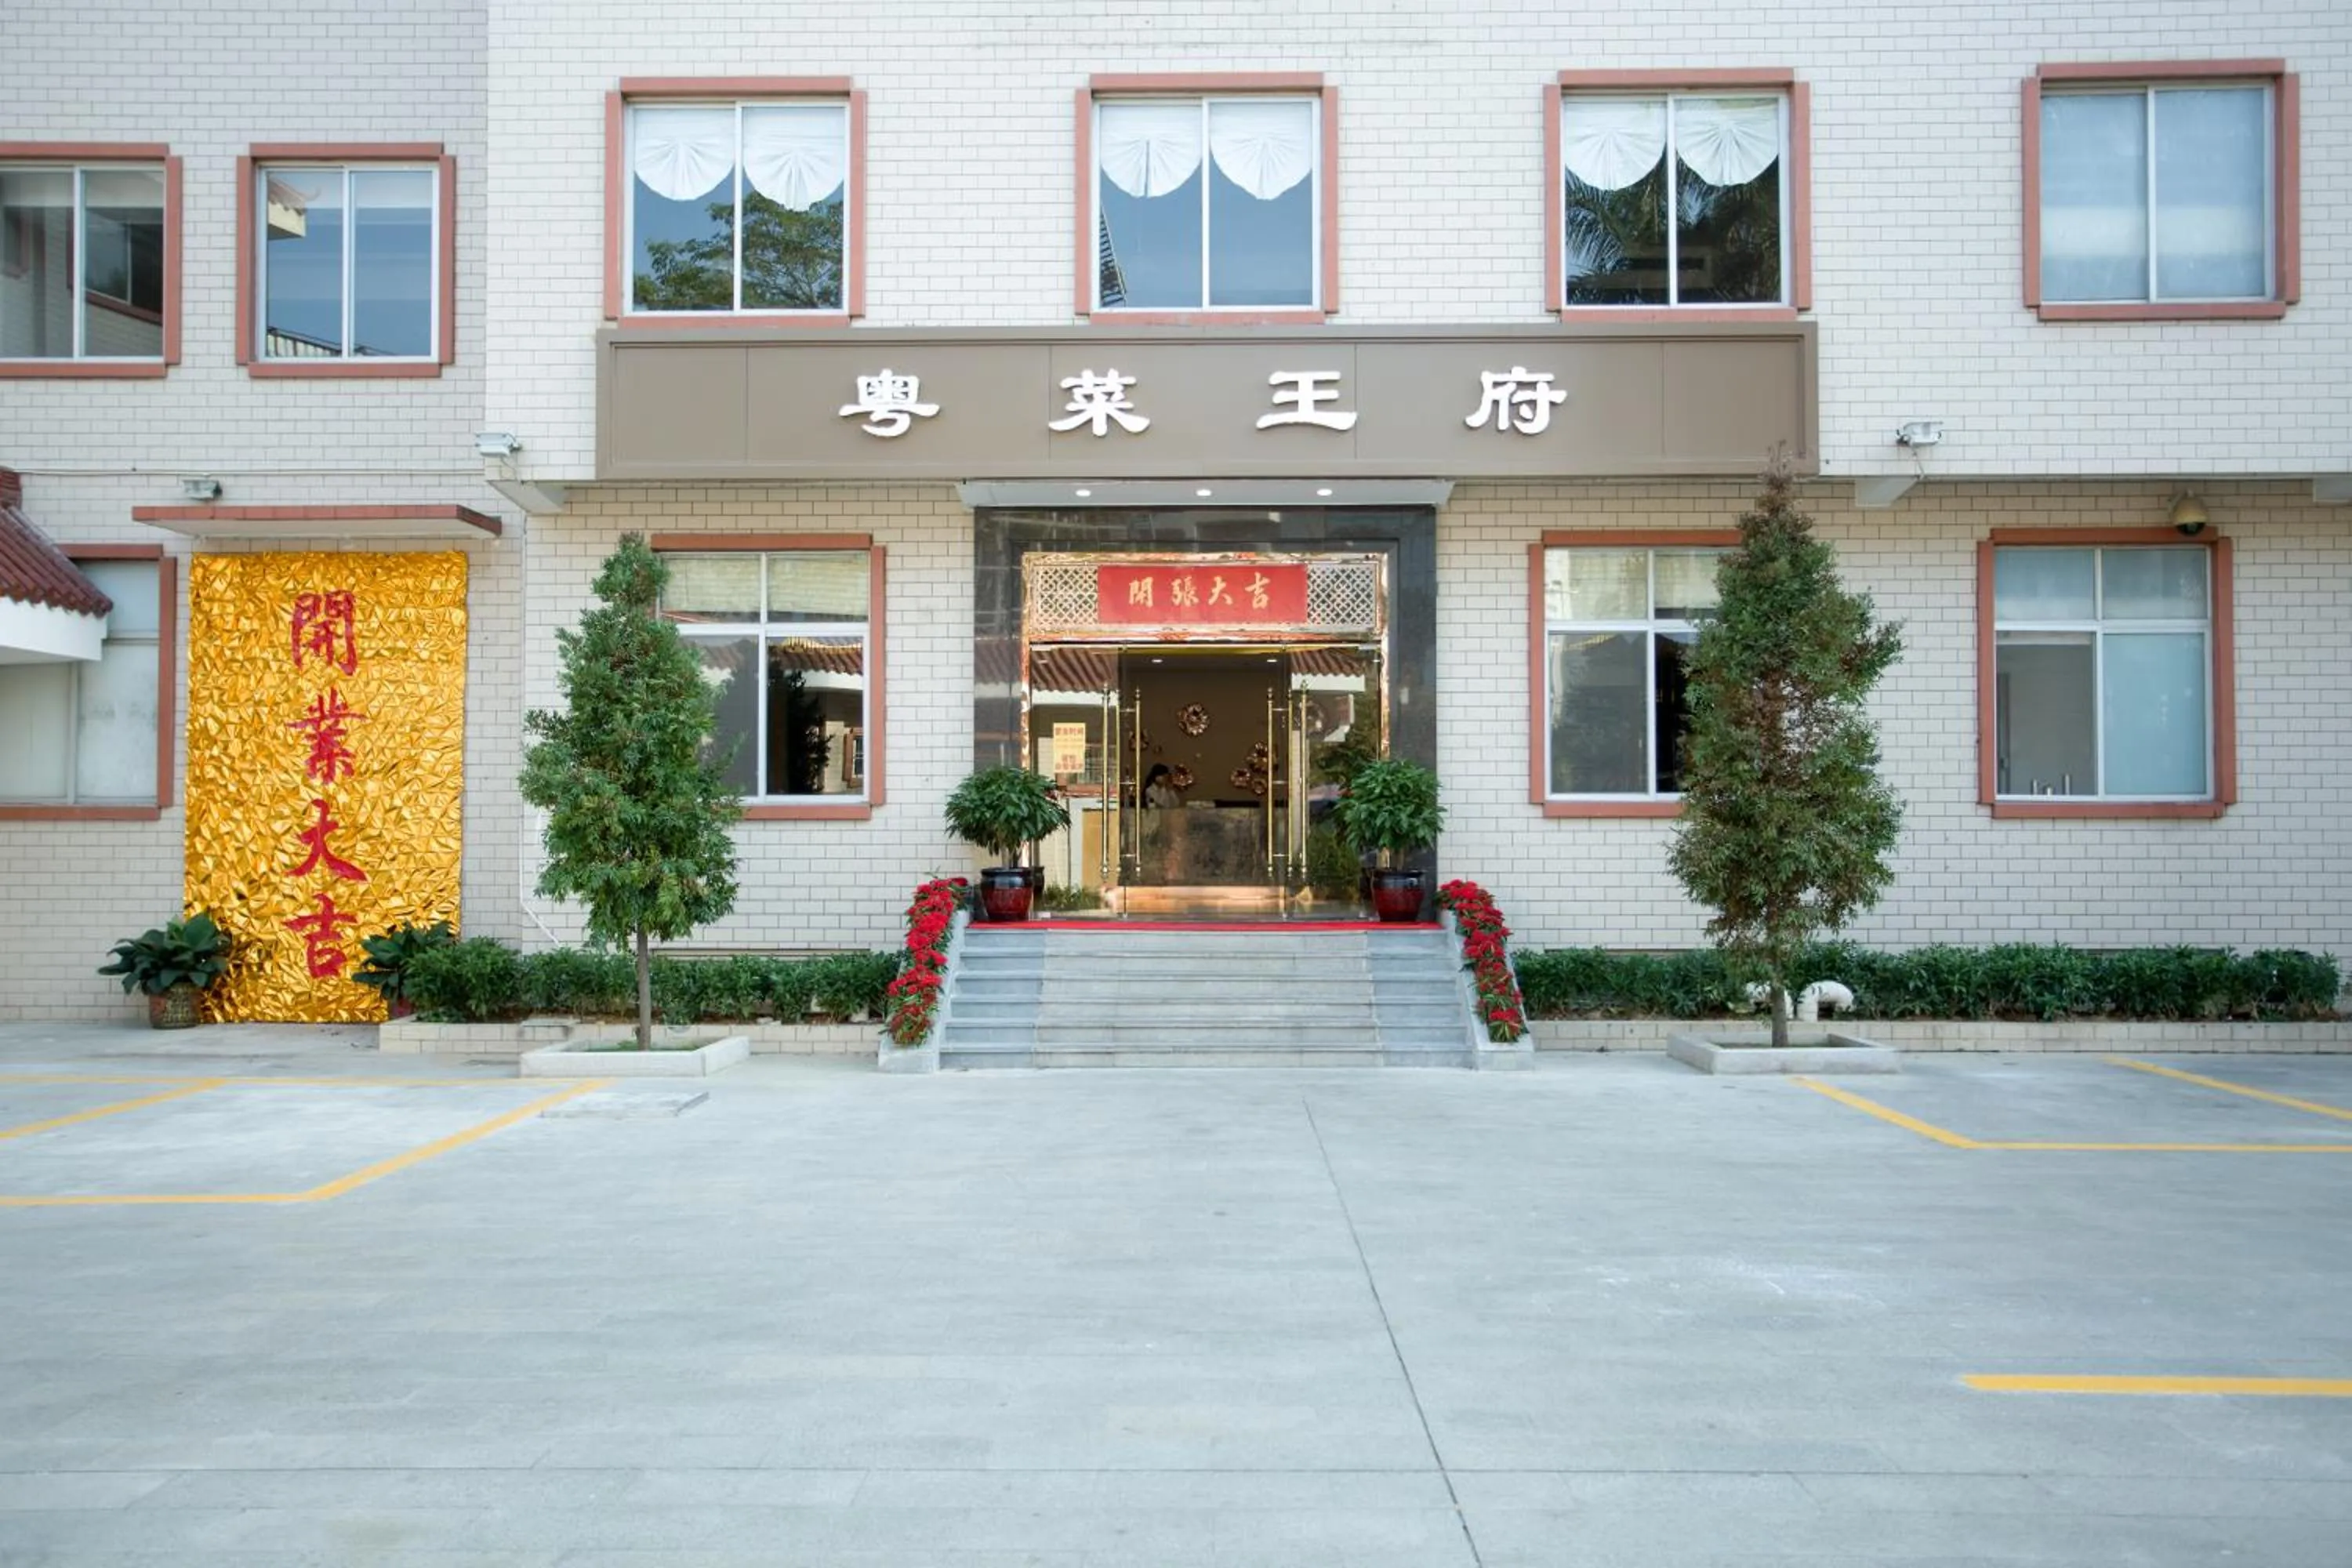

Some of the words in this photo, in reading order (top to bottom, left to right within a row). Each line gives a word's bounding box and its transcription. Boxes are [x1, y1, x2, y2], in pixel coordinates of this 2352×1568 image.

[838, 367, 1567, 437] 粤菜王府
[282, 589, 369, 979] 開業大吉
